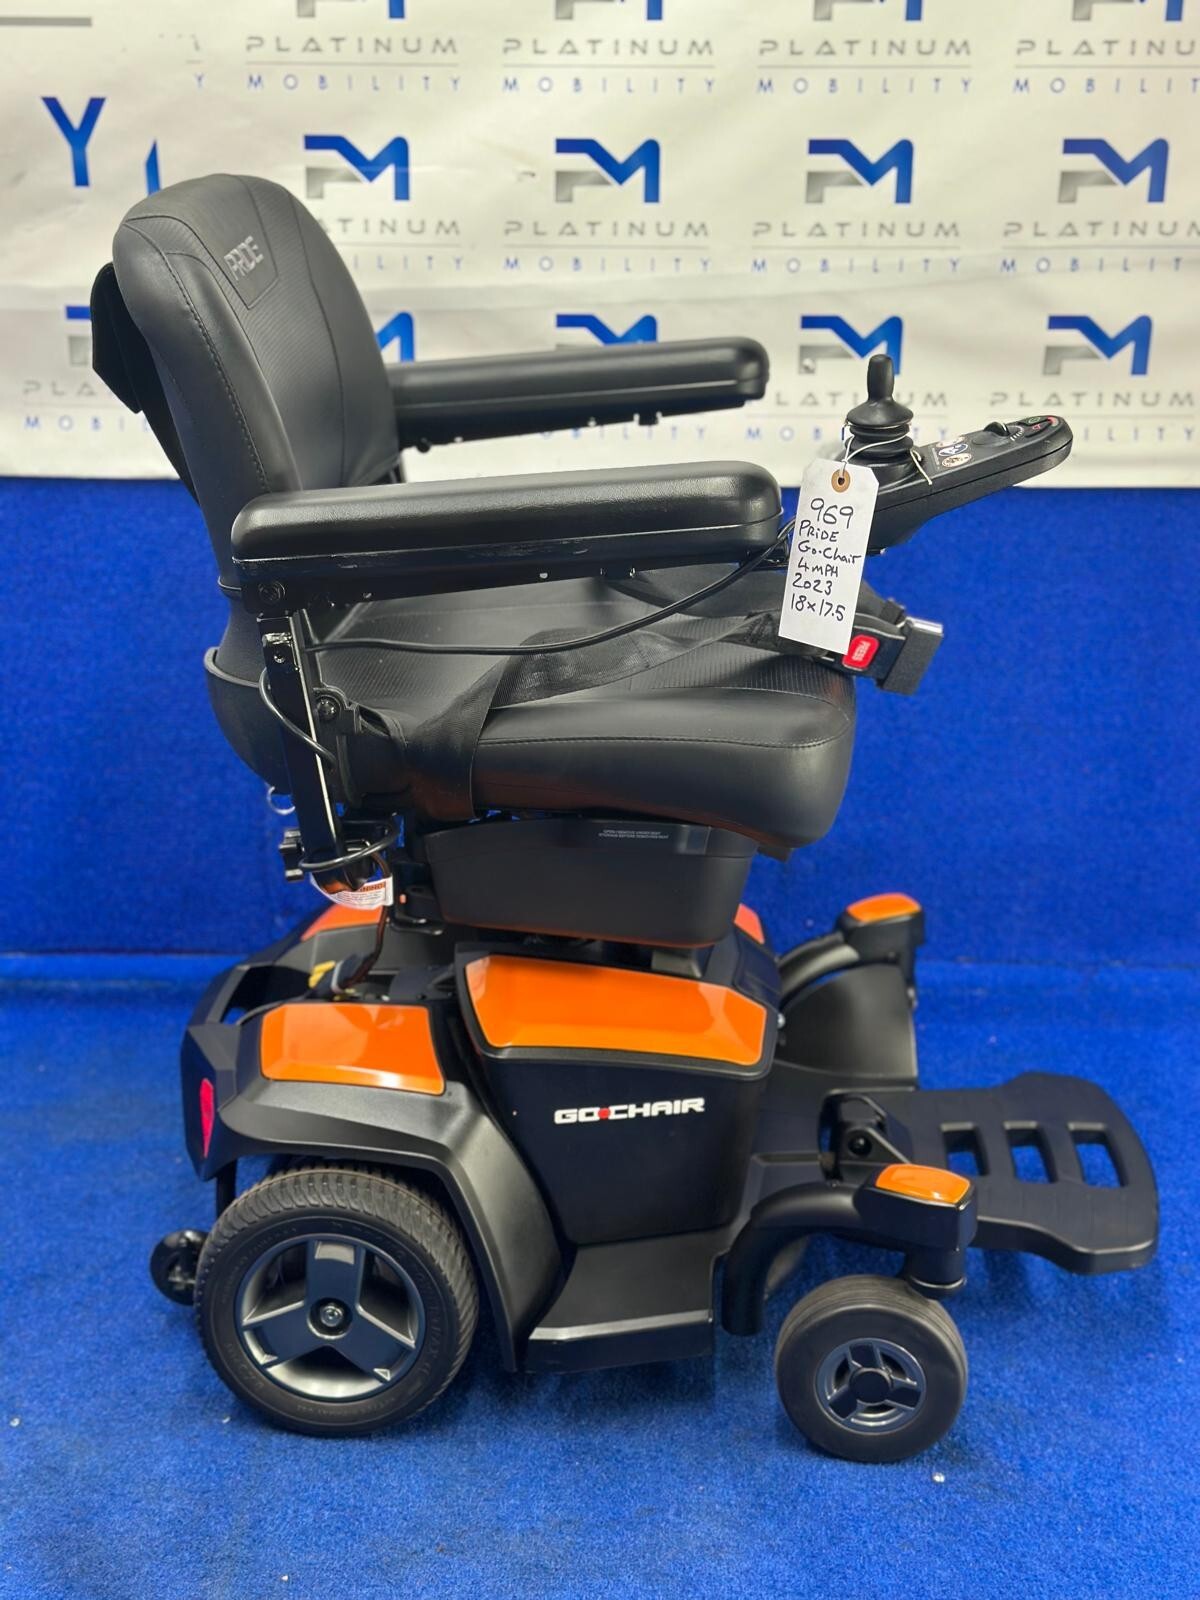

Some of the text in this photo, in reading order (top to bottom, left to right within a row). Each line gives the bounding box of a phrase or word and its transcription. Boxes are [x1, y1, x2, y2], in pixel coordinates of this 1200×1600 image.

[246, 36, 458, 54] PLATINUM
[503, 39, 714, 55] PLATINUM
[759, 40, 971, 56] PLATINUM
[247, 74, 460, 91] MOBILITY
[503, 77, 714, 93] MOBILITY
[757, 77, 972, 94] MOBILITY
[504, 221, 709, 237] PLATINUM
[752, 222, 960, 237] PLATINUM
[503, 256, 711, 272] MOBILITY
[751, 258, 960, 273] MOBILITY
[989, 391, 1195, 408] PLATINUM
[810, 497, 854, 529] 969
[792, 572, 833, 596] 2023
